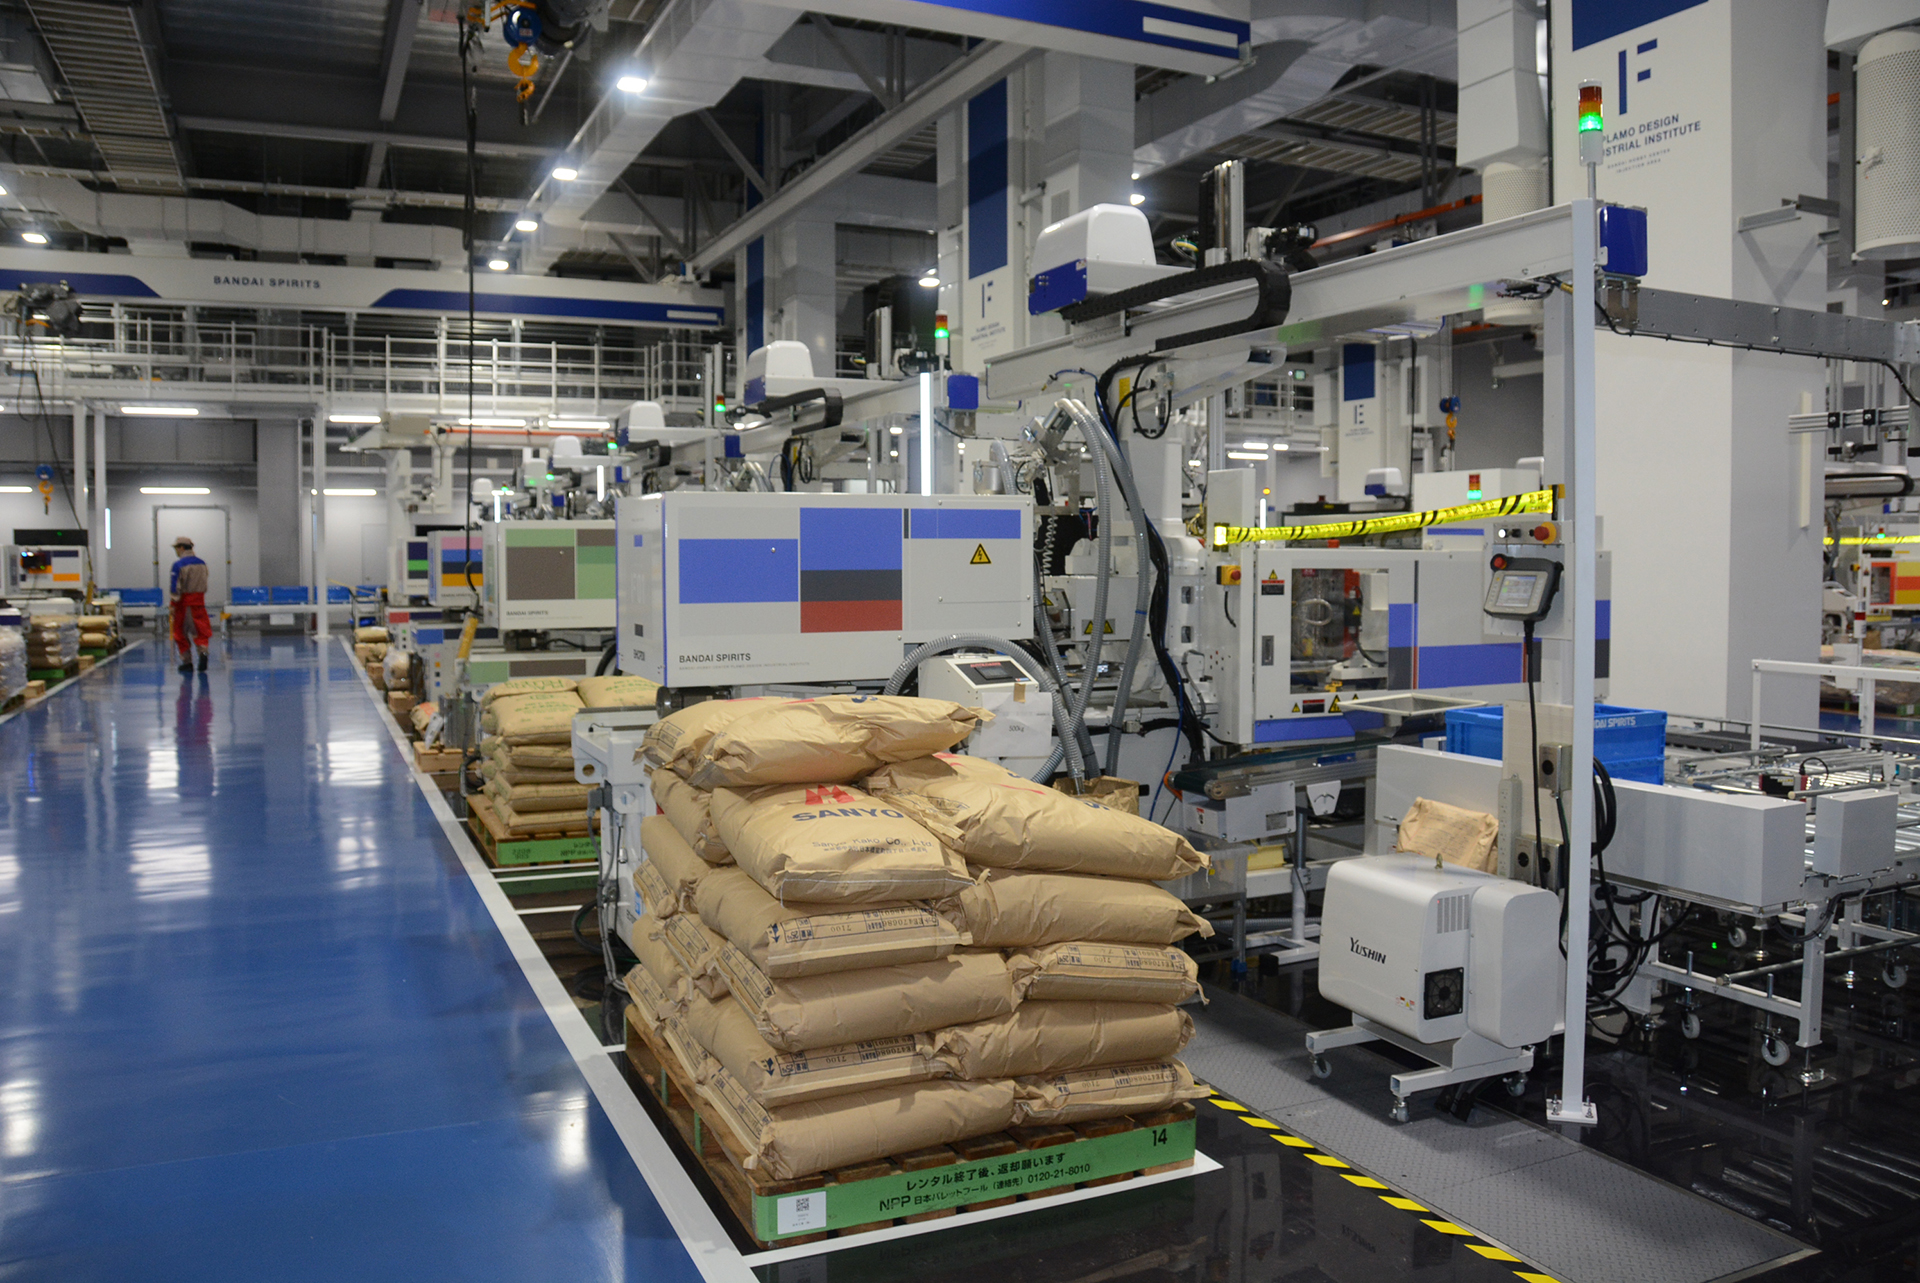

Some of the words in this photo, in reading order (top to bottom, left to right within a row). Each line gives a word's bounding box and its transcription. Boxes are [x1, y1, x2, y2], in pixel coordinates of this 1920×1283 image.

[1639, 114, 1679, 134] DESIGN
[1602, 139, 1641, 157] STRIAL
[1645, 120, 1701, 145] INSTITUTE
[214, 276, 263, 285] BANDAI
[269, 278, 320, 289] SPIRITS
[679, 654, 713, 663] BANDAI
[716, 652, 751, 662] SPIRITS
[1608, 716, 1636, 727] SPIRITS
[792, 808, 904, 822] SANYO
[1350, 937, 1386, 964] YUSHIN
[1152, 1128, 1167, 1146] 14
[907, 1152, 1065, 1191] レンタル終了後、返却願います
[880, 1195, 911, 1211] NPP
[1027, 1163, 1090, 1184] 0120-21-8010
